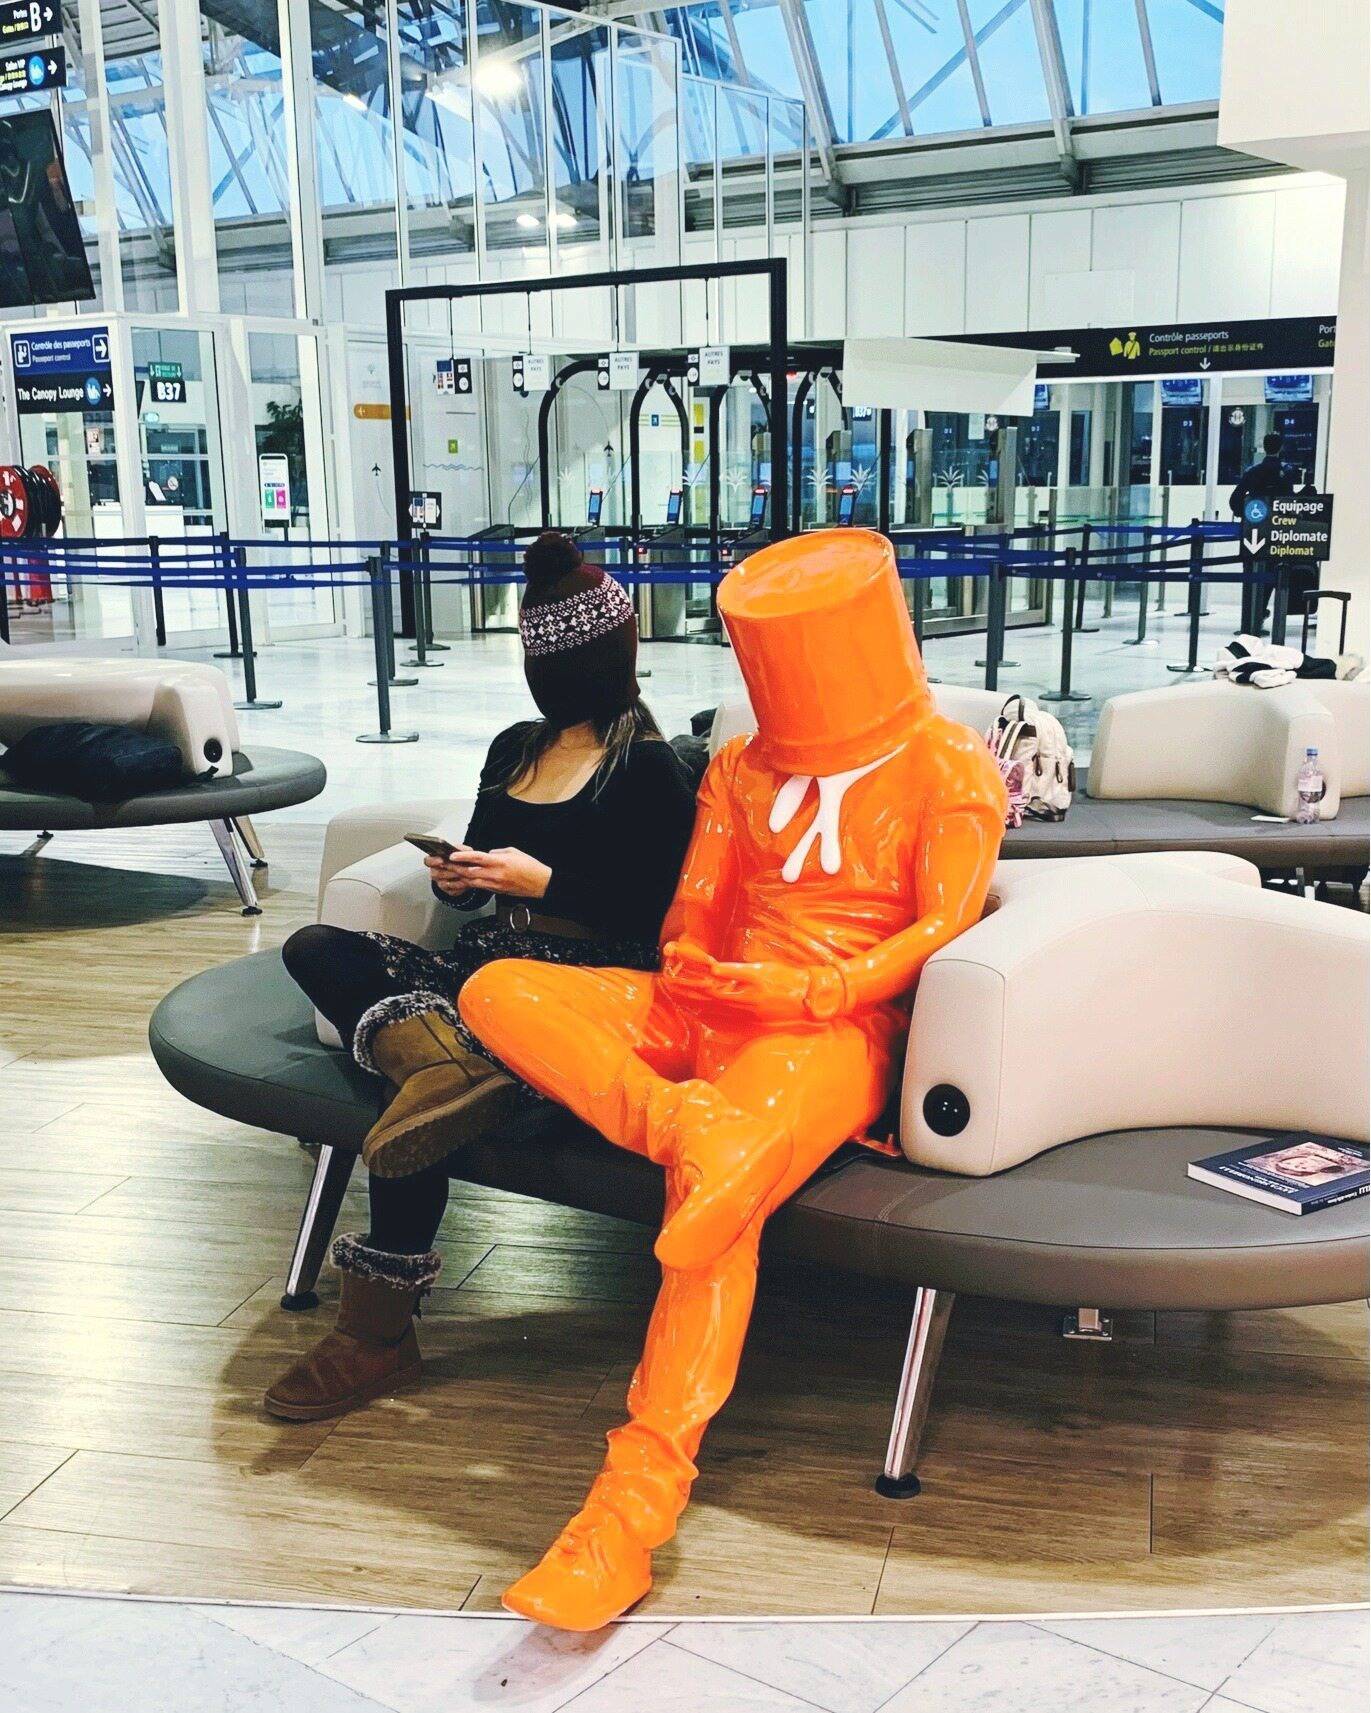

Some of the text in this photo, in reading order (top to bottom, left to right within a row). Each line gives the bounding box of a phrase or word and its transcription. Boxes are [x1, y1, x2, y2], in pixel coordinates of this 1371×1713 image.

[29, 2, 42, 32] B
[1185, 331, 1229, 342] passeports
[1180, 345, 1207, 355] control
[18, 386, 84, 402] The Canopy Lounge
[1272, 500, 1324, 514] Equipage
[1272, 516, 1297, 526] Crew
[1270, 530, 1328, 544] Diplomate
[1270, 545, 1314, 558] Diplomat
